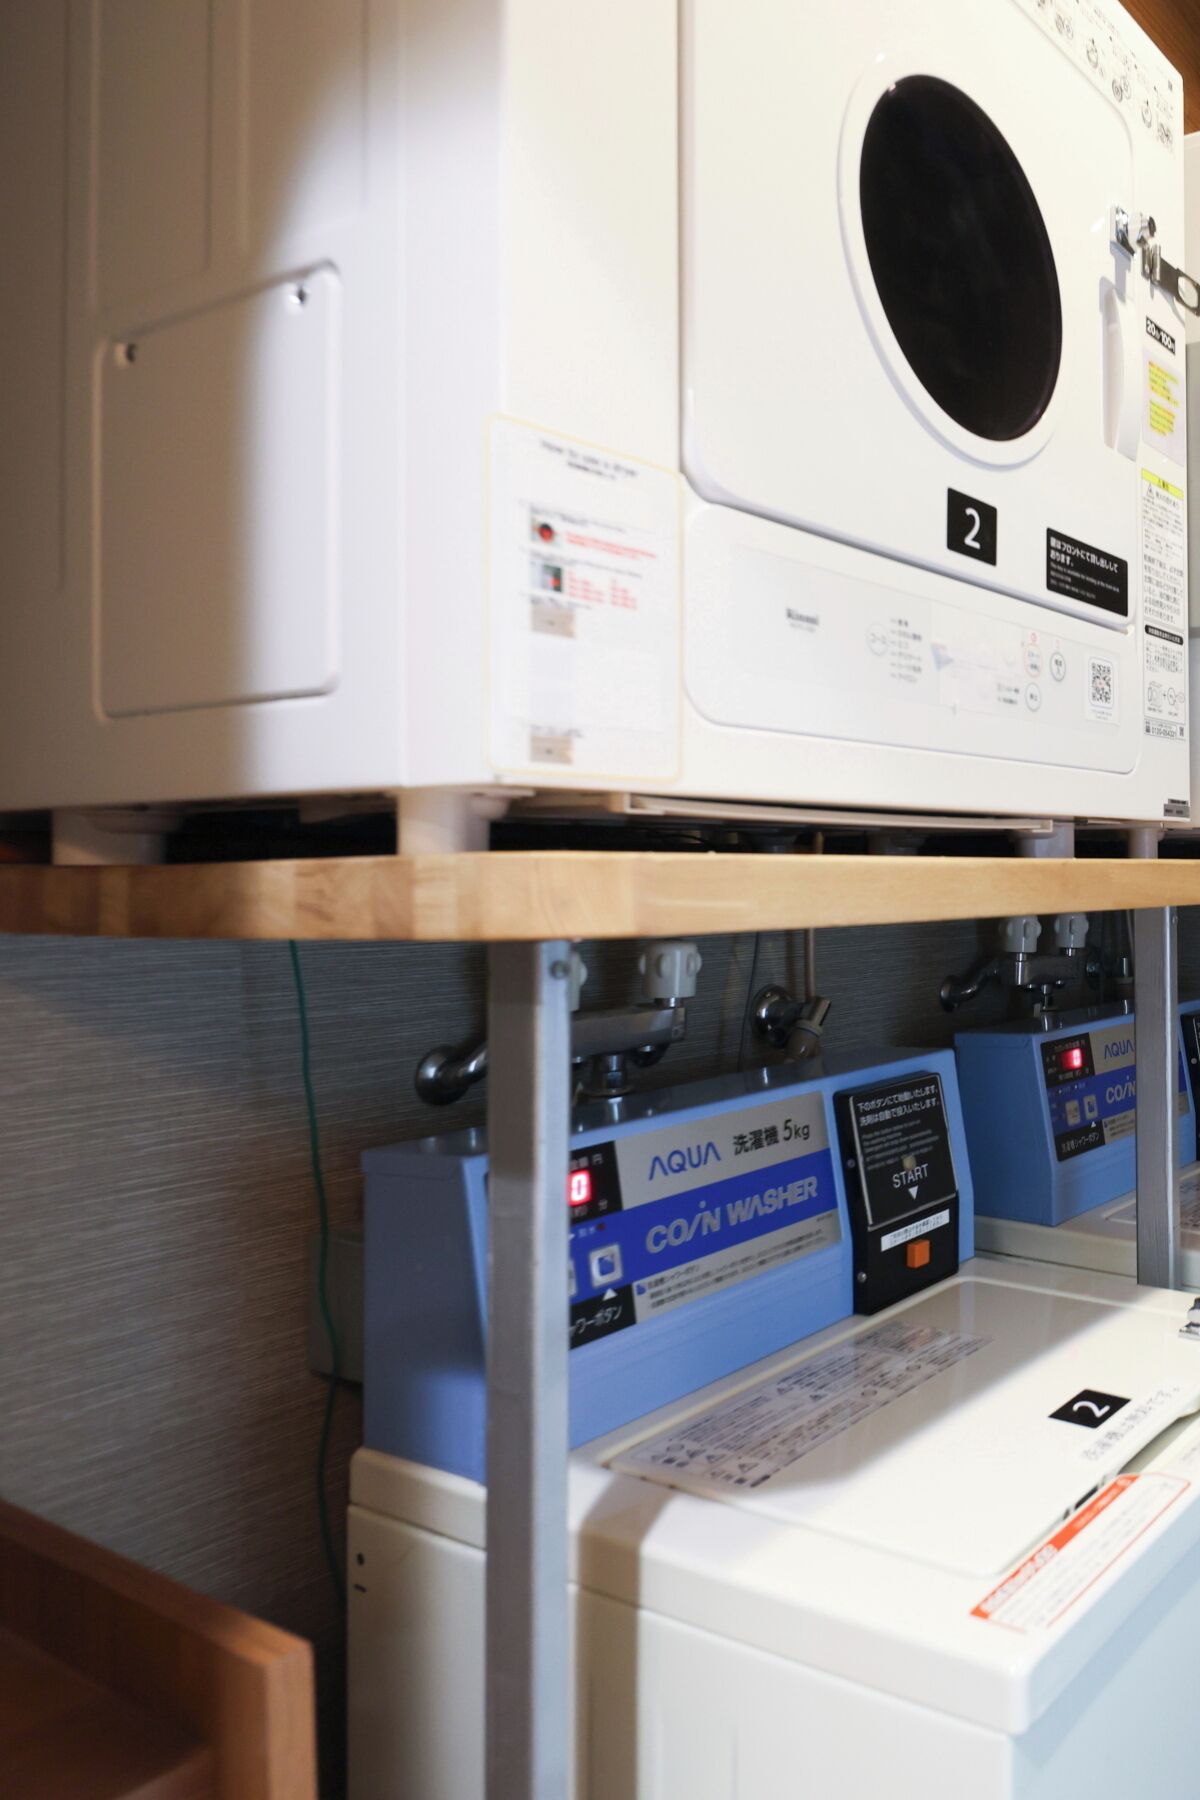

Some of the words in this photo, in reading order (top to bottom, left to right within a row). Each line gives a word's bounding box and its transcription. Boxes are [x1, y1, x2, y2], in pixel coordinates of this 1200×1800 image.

[963, 506, 982, 550] 2
[1103, 1040, 1135, 1060] AQUA
[732, 1124, 781, 1156] 洗濯機
[782, 1118, 812, 1143] 5kg
[648, 1141, 721, 1182] AQUA
[892, 1163, 930, 1189] START
[570, 1171, 589, 1203] 0
[645, 1201, 721, 1255] COIN
[727, 1176, 819, 1227] WASHER
[1072, 1400, 1111, 1418] 2
